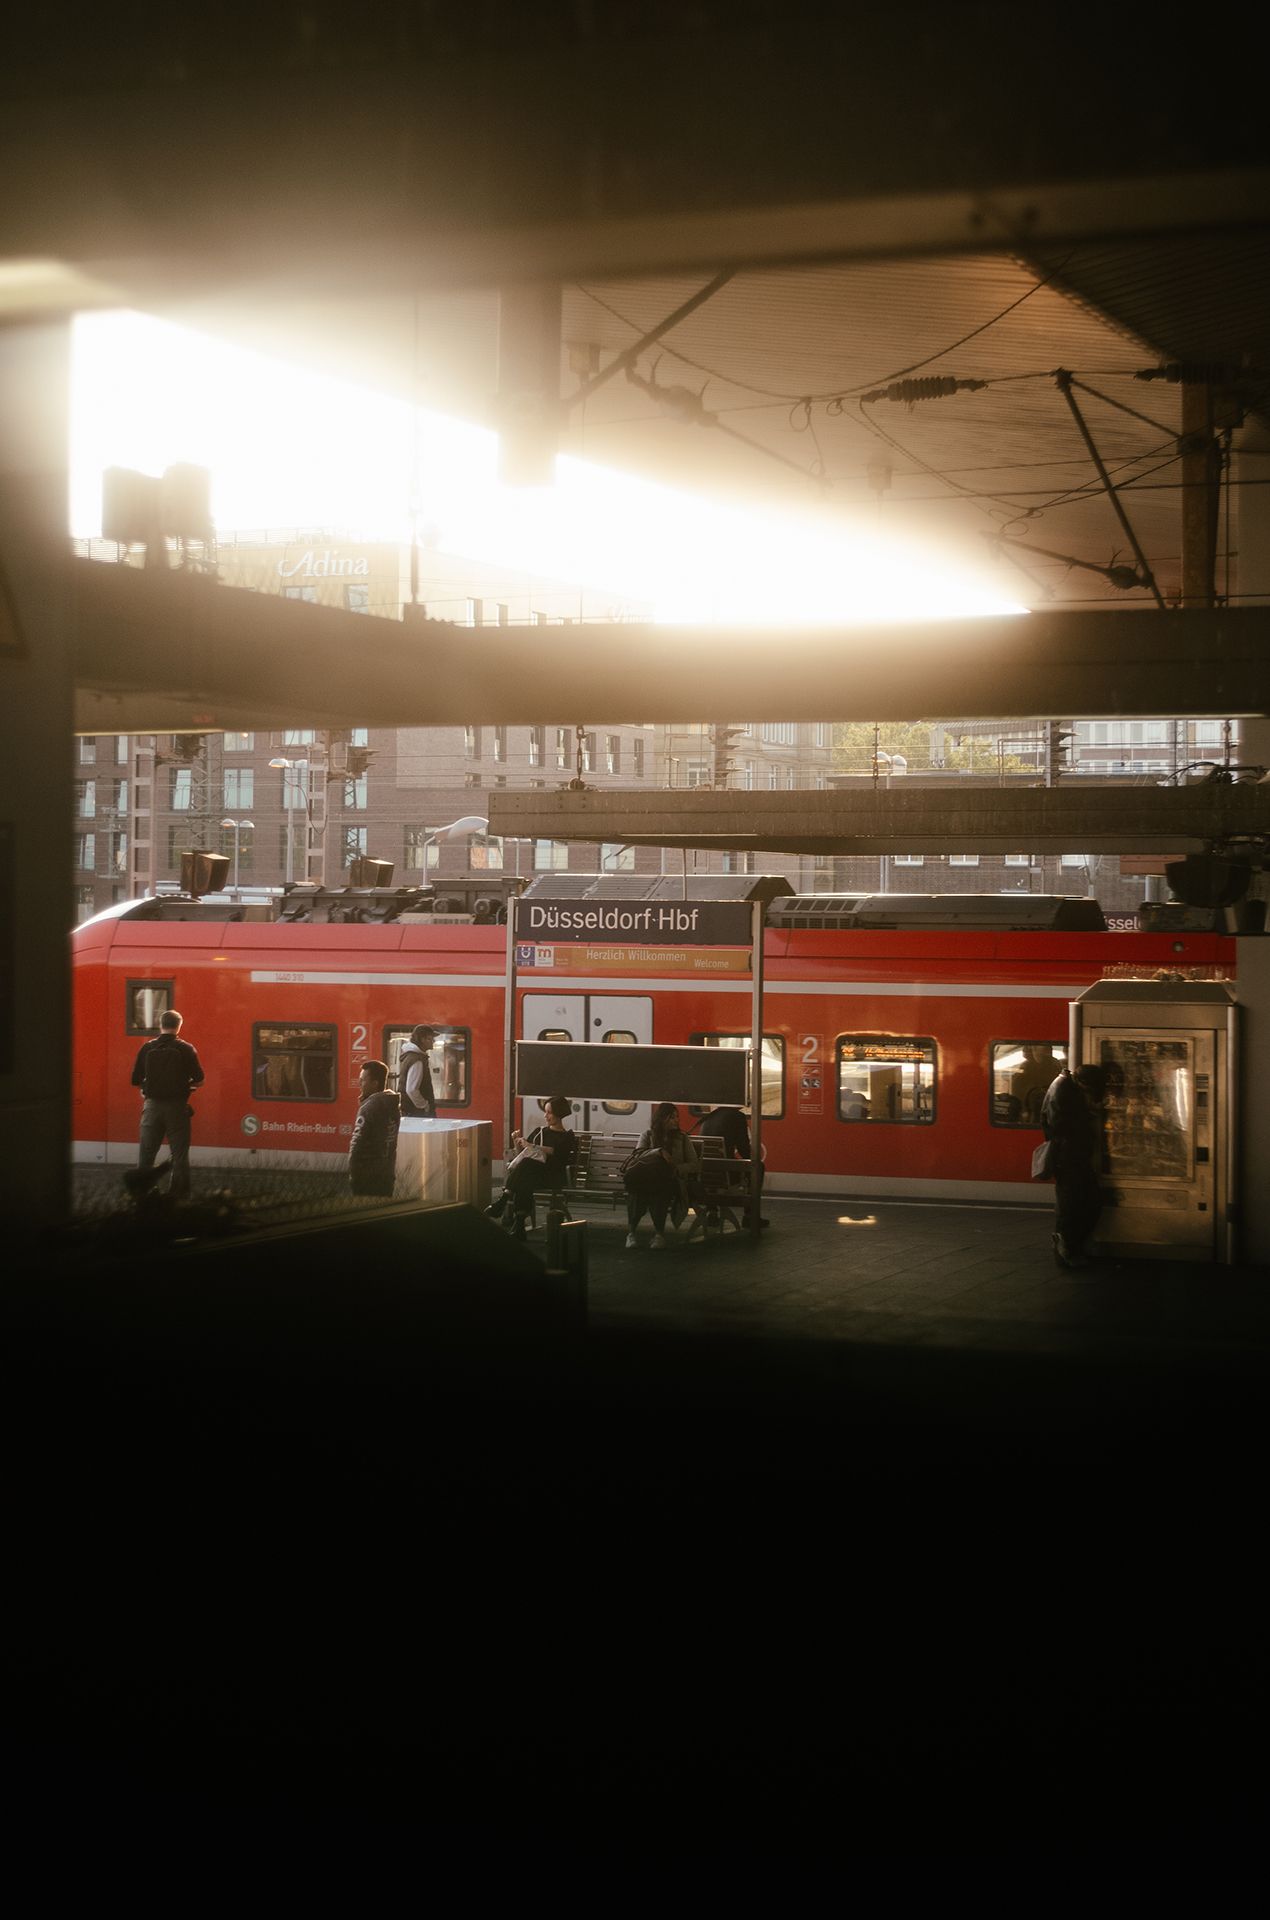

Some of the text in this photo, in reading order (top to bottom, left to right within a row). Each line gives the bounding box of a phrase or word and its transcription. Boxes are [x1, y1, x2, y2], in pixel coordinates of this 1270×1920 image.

[277, 550, 369, 577] Adina
[530, 906, 699, 931] Düsseldorf Hbf
[586, 950, 687, 962] Herzlich Willkommen
[694, 958, 729, 969] Welcome
[352, 1025, 368, 1050] 2
[802, 1036, 819, 1063] 2
[244, 1116, 258, 1134] S
[262, 1121, 285, 1132] Bahn
[287, 1122, 337, 1134] Rhein-Ruhr
